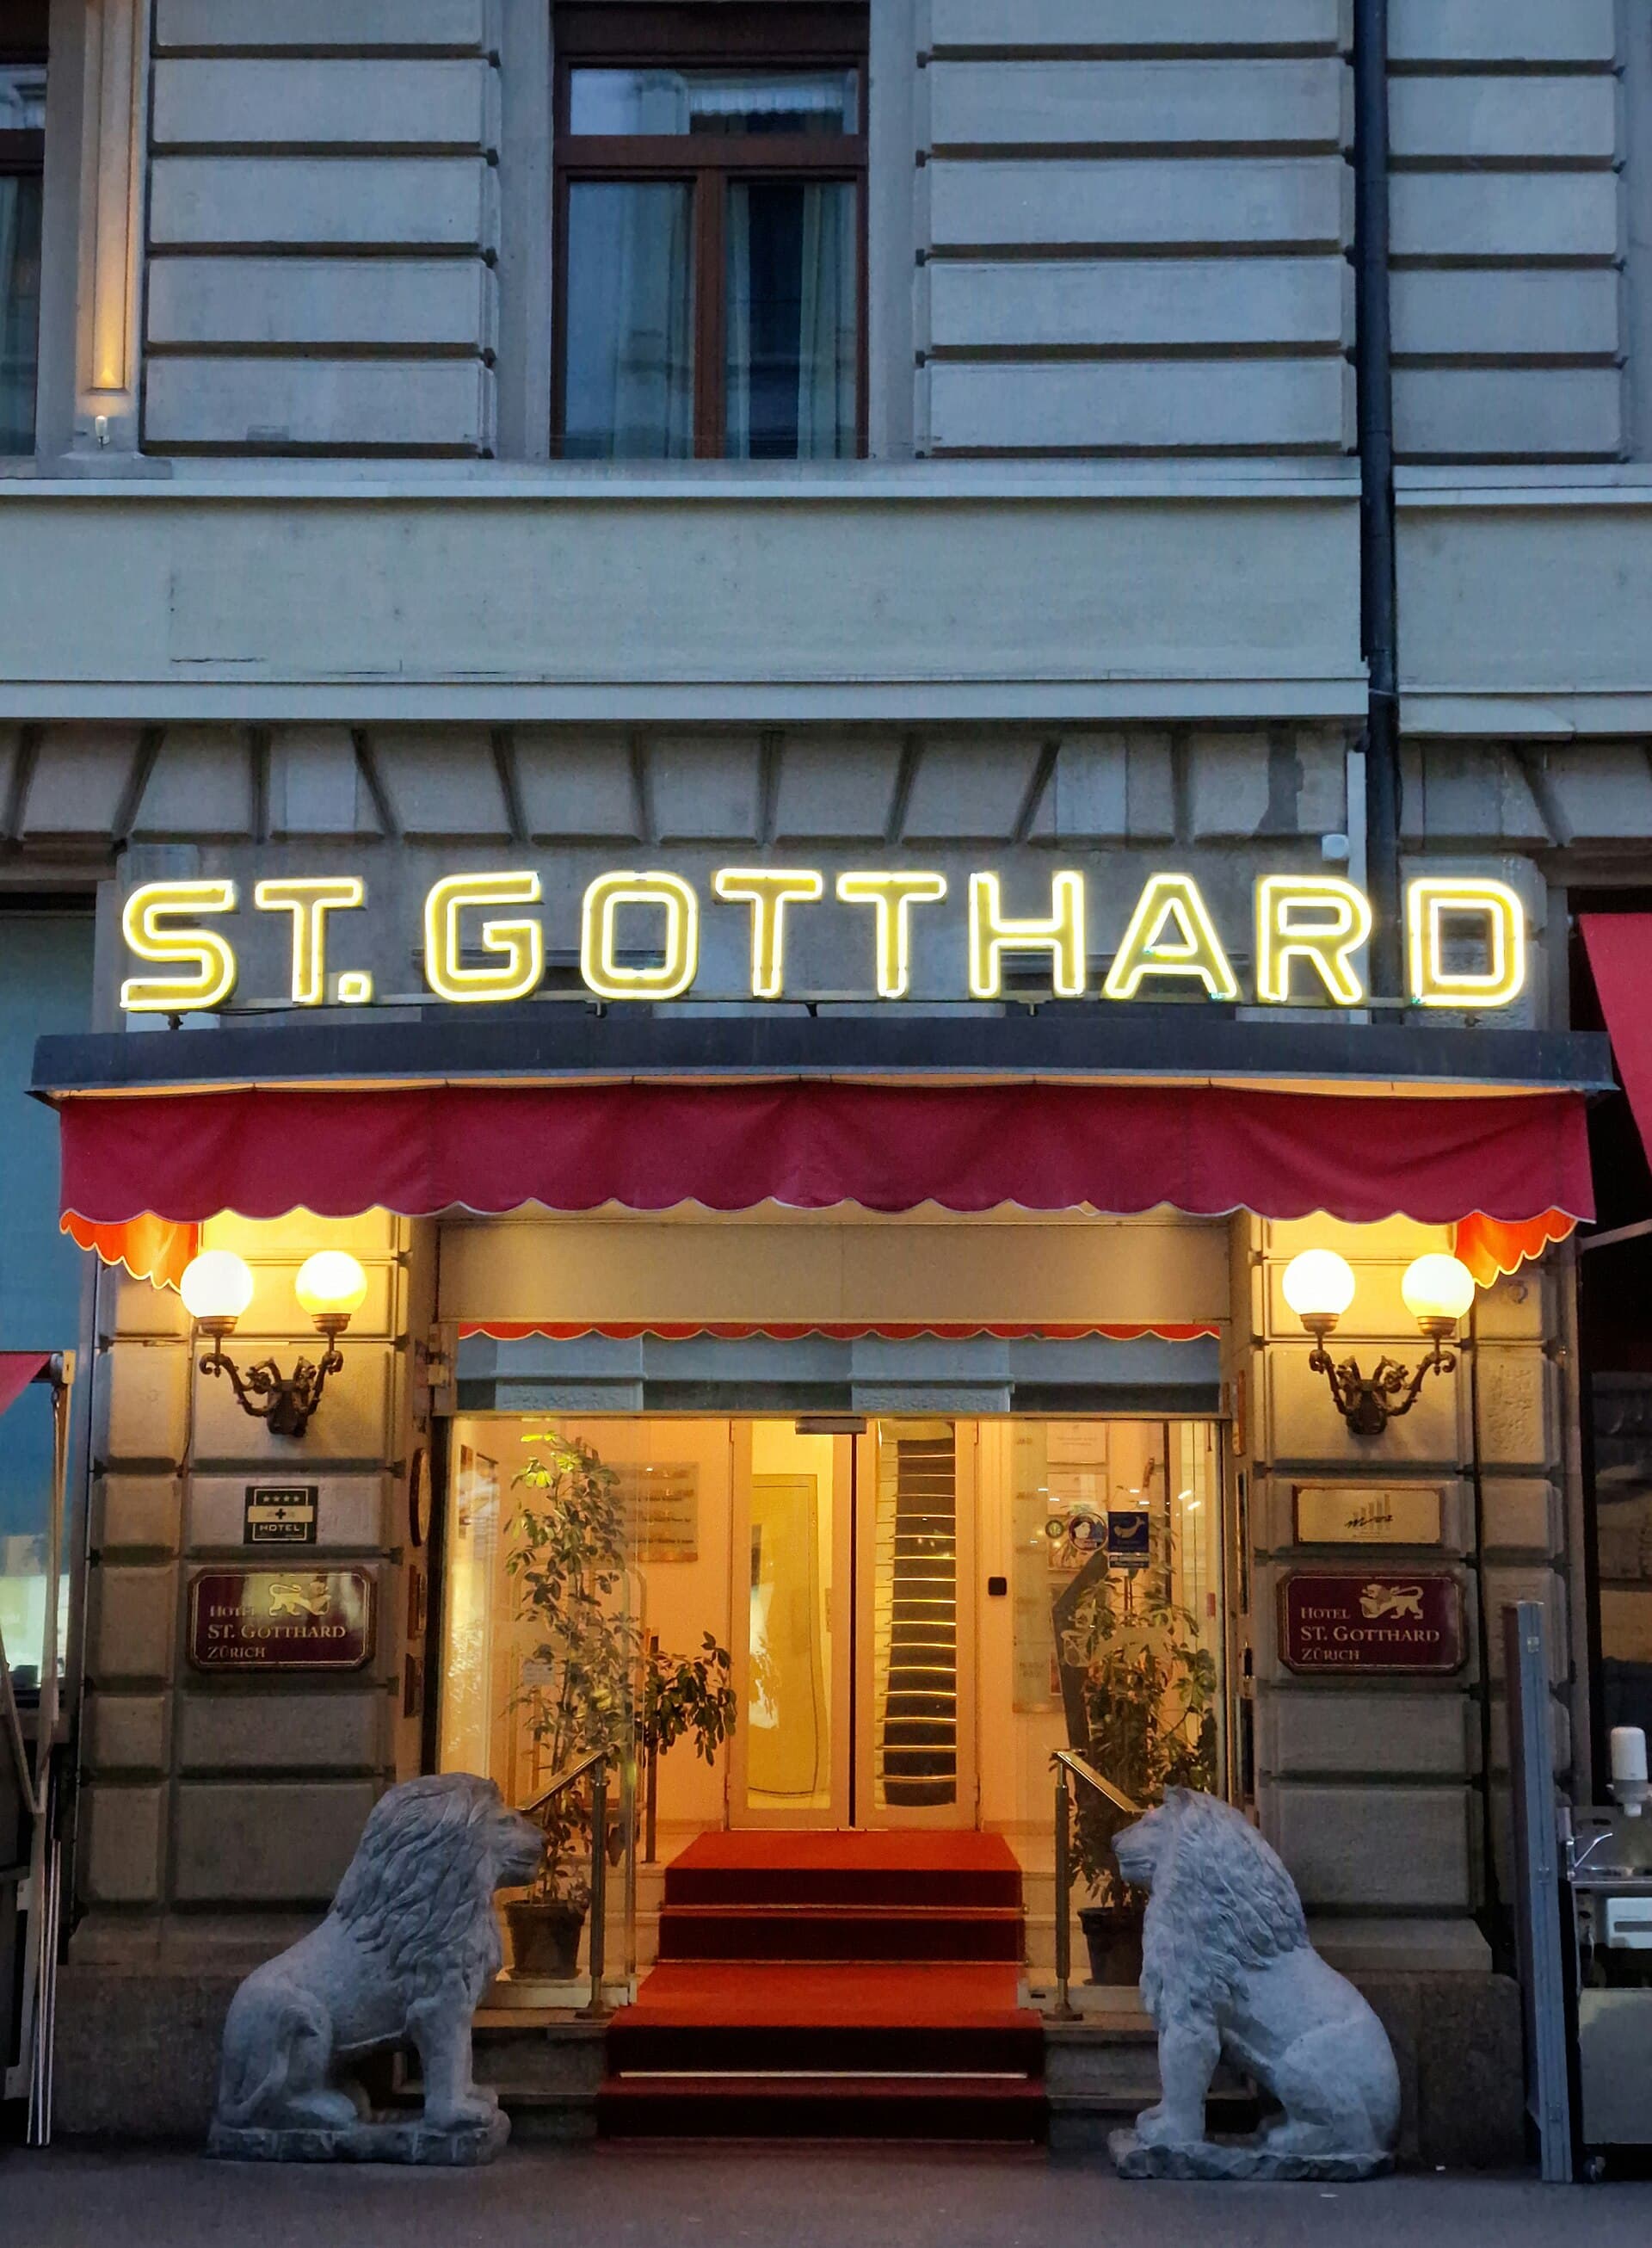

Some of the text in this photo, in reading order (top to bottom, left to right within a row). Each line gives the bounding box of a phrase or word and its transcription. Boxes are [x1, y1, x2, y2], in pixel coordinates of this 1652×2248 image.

[119, 868, 1526, 1012] ST. GOTTHARD
[1300, 1607, 1351, 1620] HOTEL
[207, 1623, 347, 1640] ST. GOTTHARD
[1300, 1626, 1440, 1642] ST. GOTTHARD
[206, 1645, 266, 1659] ZÜRICH
[1301, 1647, 1360, 1661] ZÜRICH
